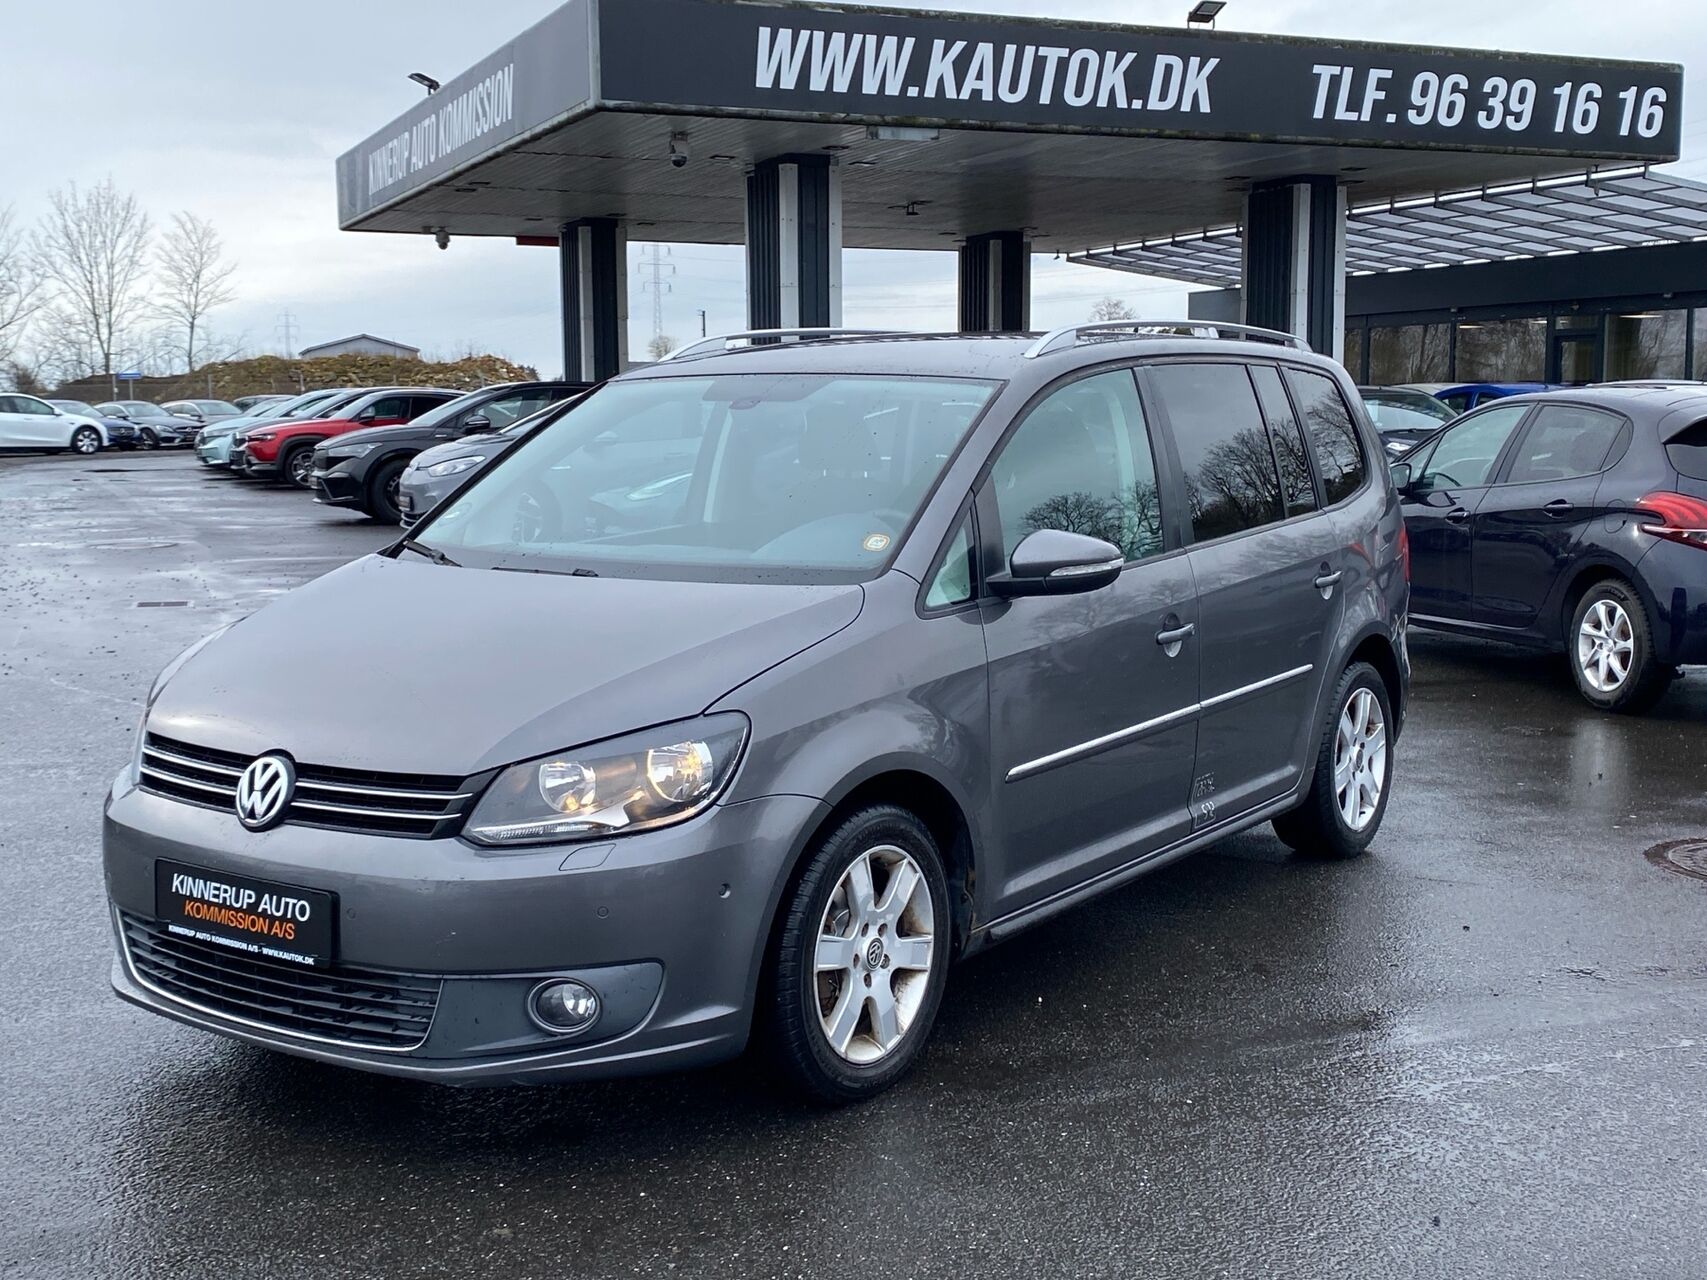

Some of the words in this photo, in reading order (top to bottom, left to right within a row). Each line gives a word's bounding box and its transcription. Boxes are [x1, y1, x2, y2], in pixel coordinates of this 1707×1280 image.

[755, 26, 1220, 113] WWW.KAUTOK.DK
[1312, 64, 1397, 123] TLF.
[1407, 71, 1469, 127] 96
[1477, 77, 1536, 131] 39
[1553, 81, 1602, 135] 16
[1618, 86, 1667, 138] 16
[369, 131, 410, 195] KINNERUP
[410, 114, 436, 173] AUTO
[438, 63, 514, 158] KOMMISSION
[236, 755, 290, 828] VW
[171, 872, 256, 909] KINNERUP
[257, 893, 310, 922] AUTO
[184, 900, 269, 934] KOMMISSION
[270, 920, 295, 940] A/S
[195, 931, 211, 942] AUTO
